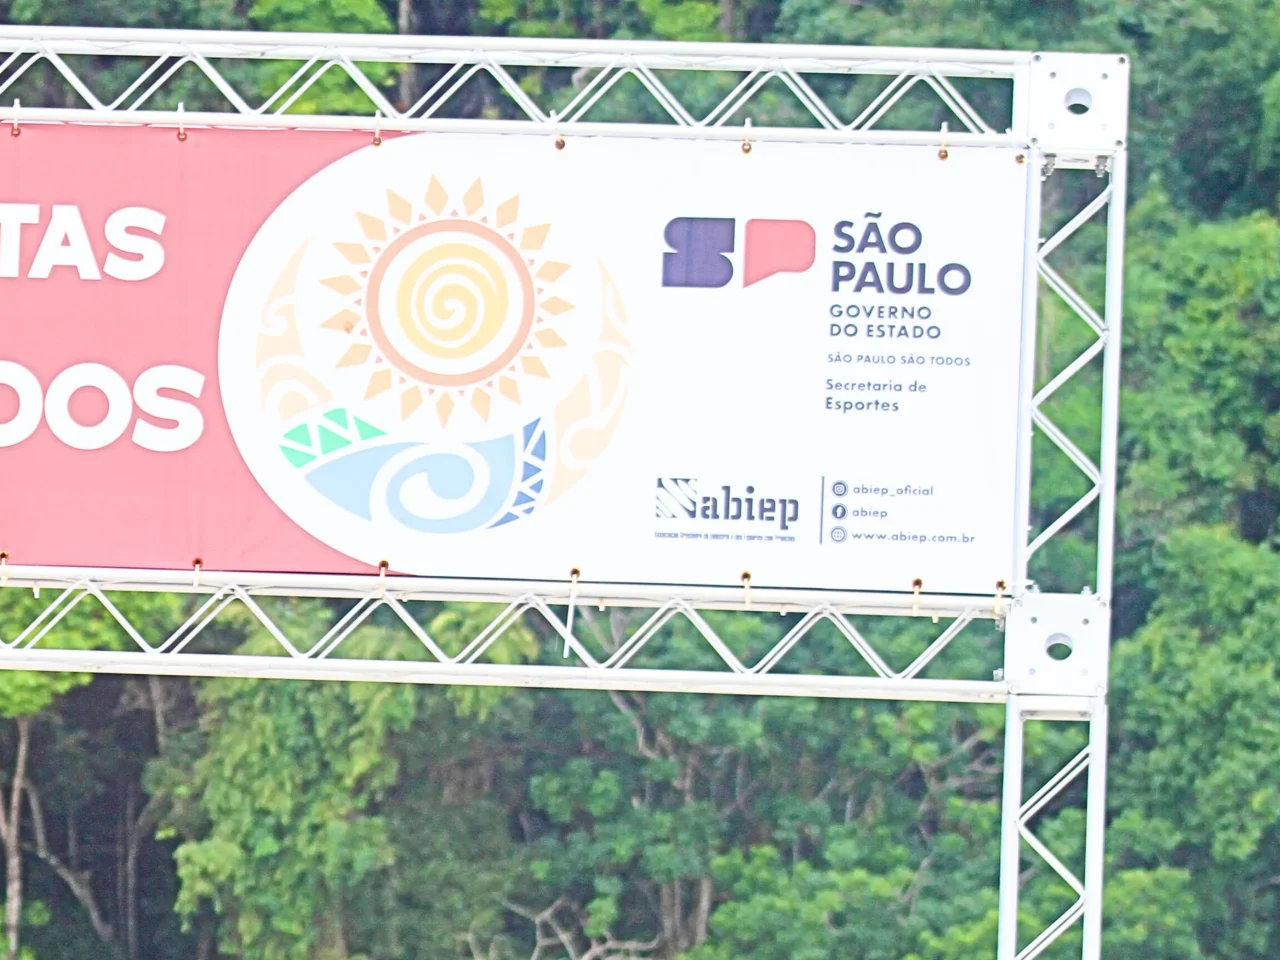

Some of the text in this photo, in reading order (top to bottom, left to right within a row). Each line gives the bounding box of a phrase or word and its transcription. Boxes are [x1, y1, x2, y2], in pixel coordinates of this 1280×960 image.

[832, 211, 923, 255] SÃO
[831, 261, 972, 296] PAULO
[829, 304, 932, 320] GOVERNO
[829, 323, 942, 340] DO ESTADO
[827, 352, 971, 367] SÃO PAULO SÃO TODOS
[825, 378, 927, 393] Secretaria de
[825, 396, 899, 414] Esportes
[853, 484, 934, 497] abiep_oficial
[700, 485, 800, 530] abiep
[852, 507, 888, 520] abiep
[851, 531, 976, 545] www.abiep.com.br
